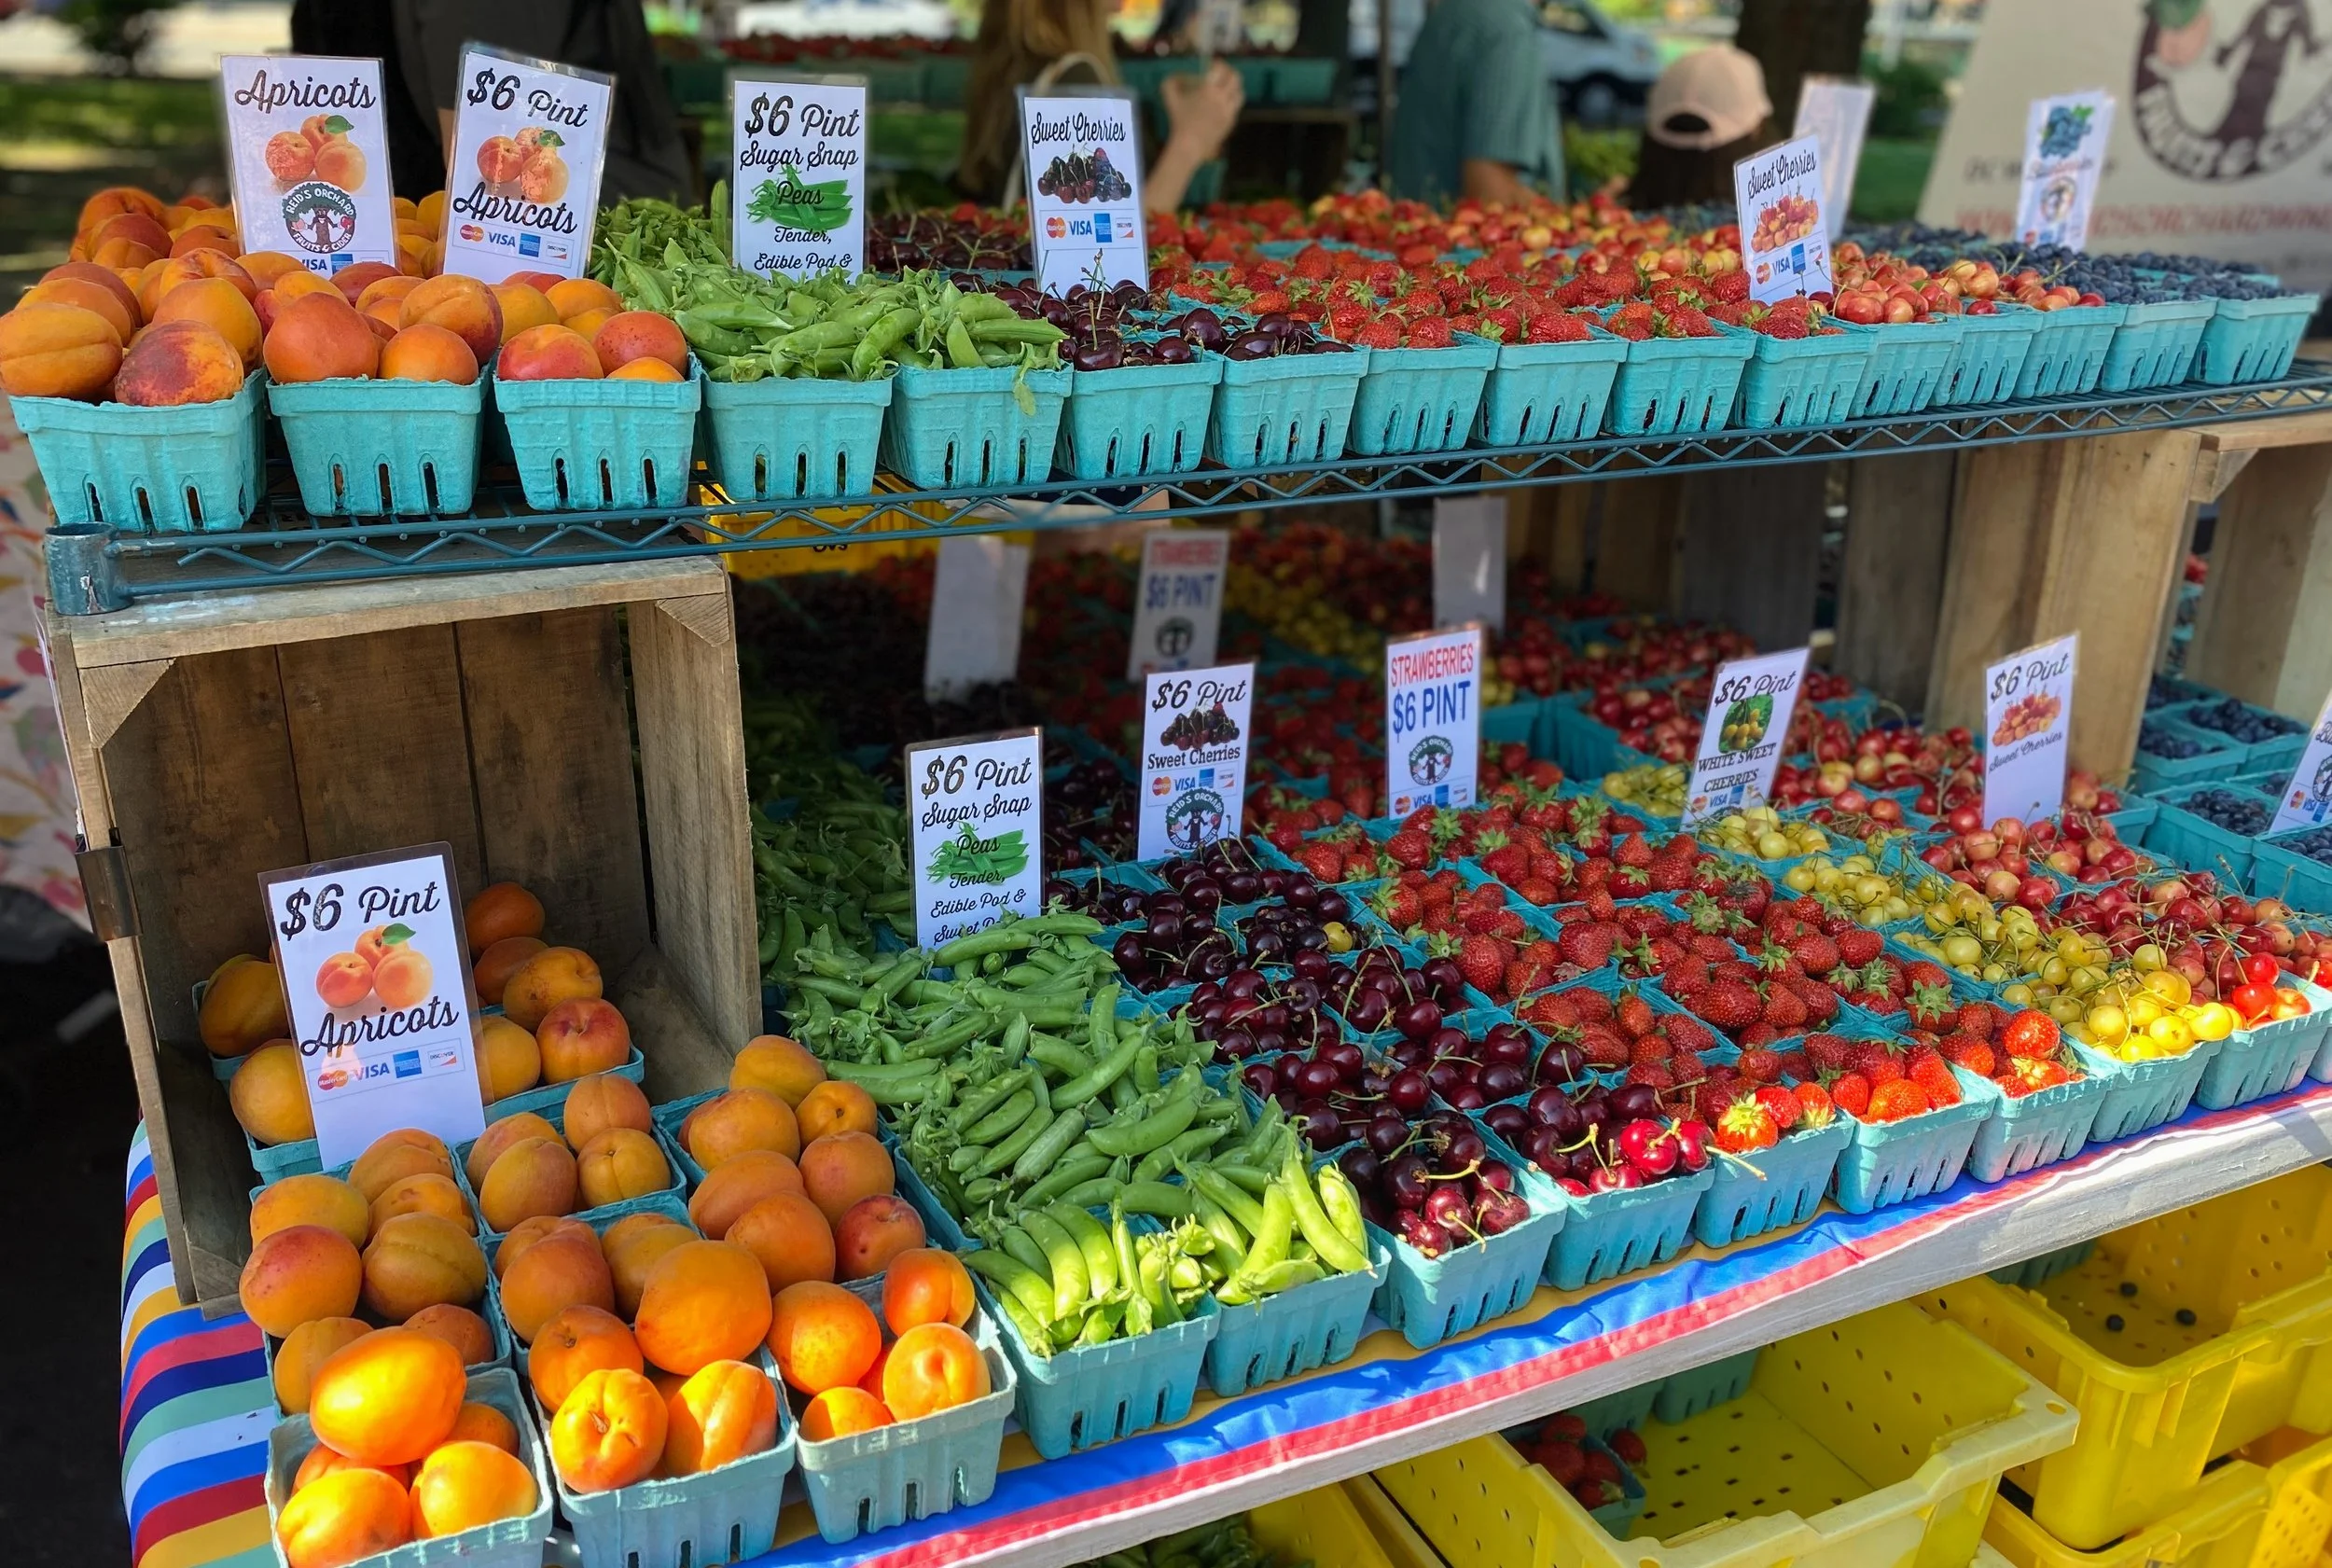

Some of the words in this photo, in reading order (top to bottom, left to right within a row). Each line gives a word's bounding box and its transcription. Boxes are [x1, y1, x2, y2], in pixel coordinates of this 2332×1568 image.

[234, 69, 376, 114] Apricots
[466, 67, 521, 110] $6
[527, 90, 588, 127] Pint
[744, 91, 794, 139] $6
[800, 104, 859, 137] Pint
[1031, 112, 1071, 149] Sweet
[1072, 111, 1126, 143] Cherries
[740, 140, 804, 173] Sugar
[807, 141, 858, 172] Snap
[776, 180, 825, 205] Peas
[1747, 162, 1776, 205] Sweet
[1774, 149, 1817, 184] Cherries
[285, 189, 312, 215] REID'S
[314, 187, 354, 215] ORCHARD
[452, 181, 577, 234] Apricots
[292, 232, 321, 252] FRUITS
[322, 243, 329, 252] &
[331, 233, 352, 251] CIDER
[487, 231, 516, 247] VISA
[774, 226, 832, 244] Tender,
[1068, 220, 1092, 235] VISA
[754, 252, 803, 271] Edible
[806, 252, 837, 269] Pod
[840, 253, 853, 269] &
[1772, 256, 1791, 276] VISA
[1173, 572, 1216, 611] PINT
[1391, 643, 1474, 687] STRAWBERRIES
[1991, 665, 2022, 703] $6
[2026, 652, 2070, 687] Pint
[1152, 679, 1192, 713] $6
[1197, 679, 1246, 706] Pint
[1714, 675, 1752, 707] $6
[1753, 671, 1797, 699] Pint
[1393, 689, 1416, 743] $6
[1423, 680, 1471, 728] PINT
[1147, 753, 1186, 770] Sweet
[1189, 745, 1241, 766] Cherries
[1698, 752, 1736, 773] WHITE
[1738, 742, 1777, 765] SWEET
[1989, 748, 2019, 774] Sweet
[2020, 730, 2062, 756] Cherries
[921, 755, 967, 800] $6
[975, 756, 1032, 790] Pint
[1174, 777, 1196, 792] VISA
[1703, 769, 1759, 793] CHERRIES
[922, 801, 980, 832] Sugar
[983, 793, 1033, 823] Snap
[1169, 795, 1192, 818] REID'S
[1194, 792, 1223, 812] ORCHARD
[1413, 794, 1433, 809] VISA
[1709, 793, 1728, 808] VISA
[956, 834, 1000, 857] Peas
[950, 868, 1006, 889] Tender,
[280, 882, 344, 941] $6
[358, 881, 440, 923] Pint
[930, 897, 978, 918] Edible
[979, 891, 1011, 909] Pod
[1013, 888, 1026, 903] &
[299, 995, 459, 1059] Apricots
[352, 1062, 390, 1081] VISA
